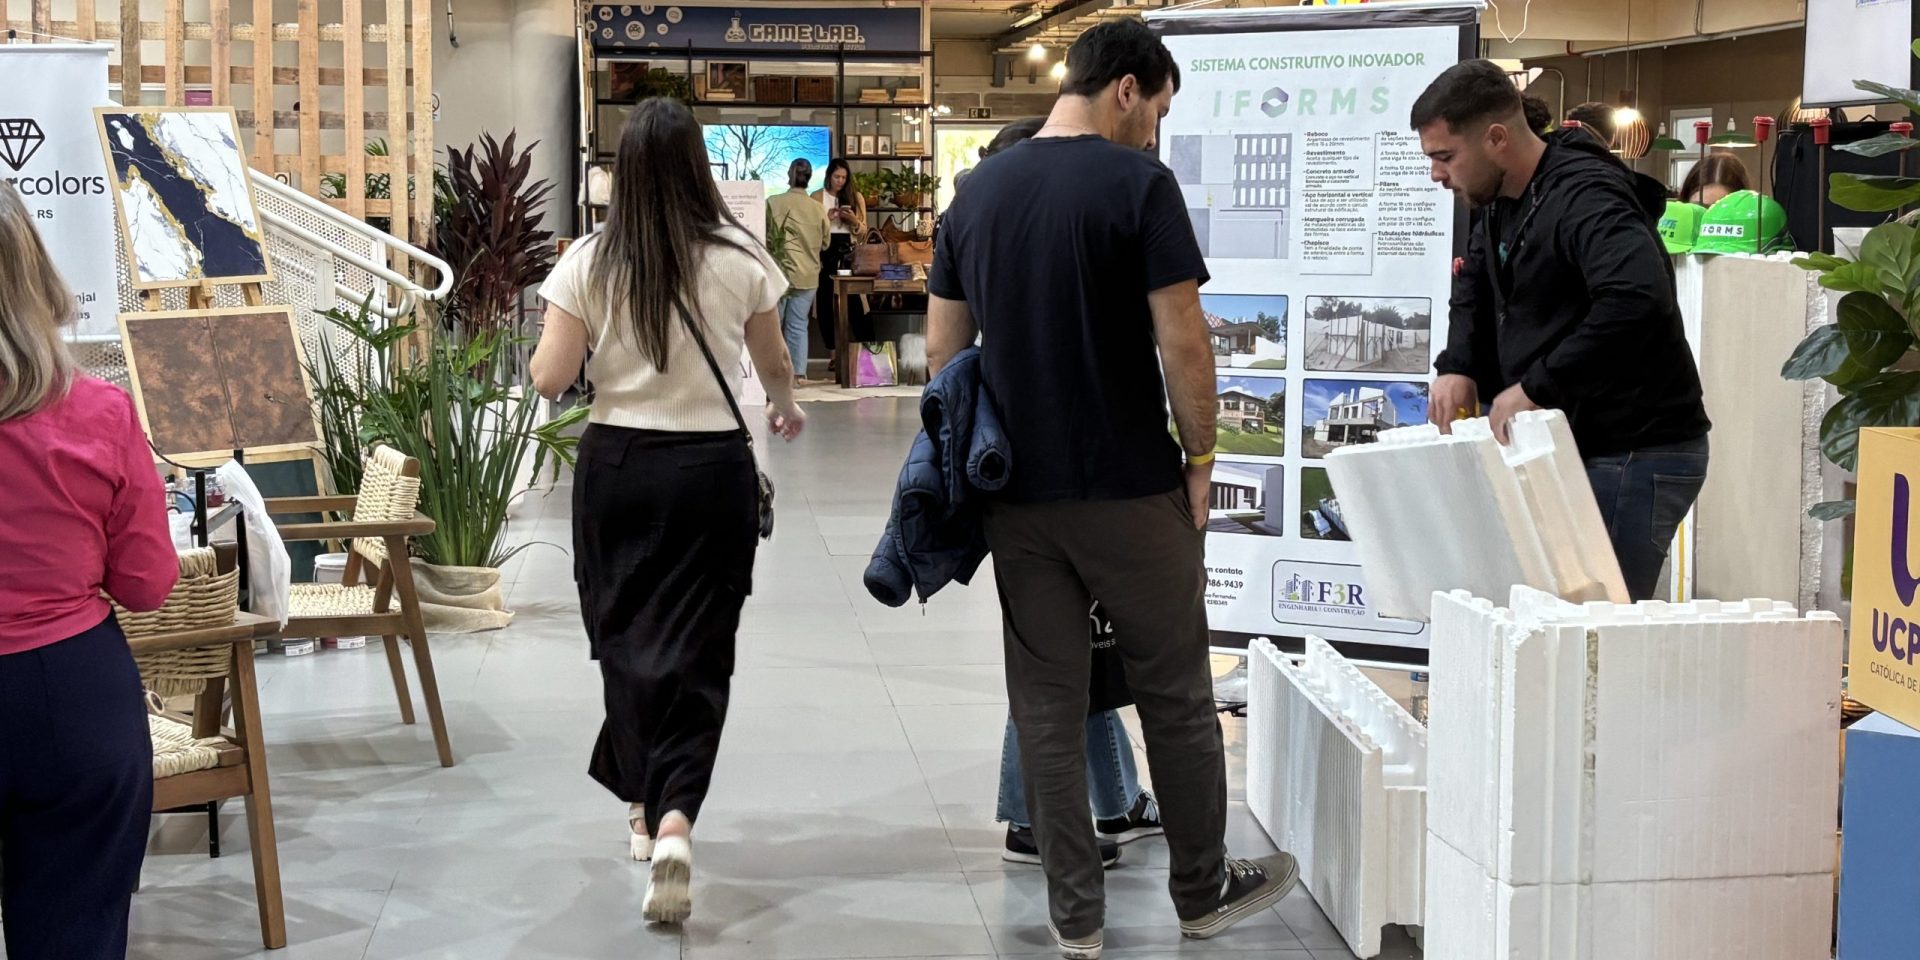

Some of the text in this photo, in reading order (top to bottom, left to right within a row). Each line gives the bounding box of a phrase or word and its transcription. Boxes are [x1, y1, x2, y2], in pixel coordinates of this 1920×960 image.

[749, 24, 866, 43] GAME LAB.
[1190, 52, 1425, 72] SISTEMA CONSTRUTIVO INOVADOR
[6, 170, 104, 195] colors
[38, 210, 53, 219] RS
[76, 292, 96, 304] njal
[1208, 579, 1243, 589] 186-9439
[1318, 581, 1365, 606] F3R
[1279, 603, 1318, 612] ENGENHARIA
[1324, 606, 1365, 616] CONSTRUÇÃO
[1870, 662, 1917, 692] CATÓLICA DE
